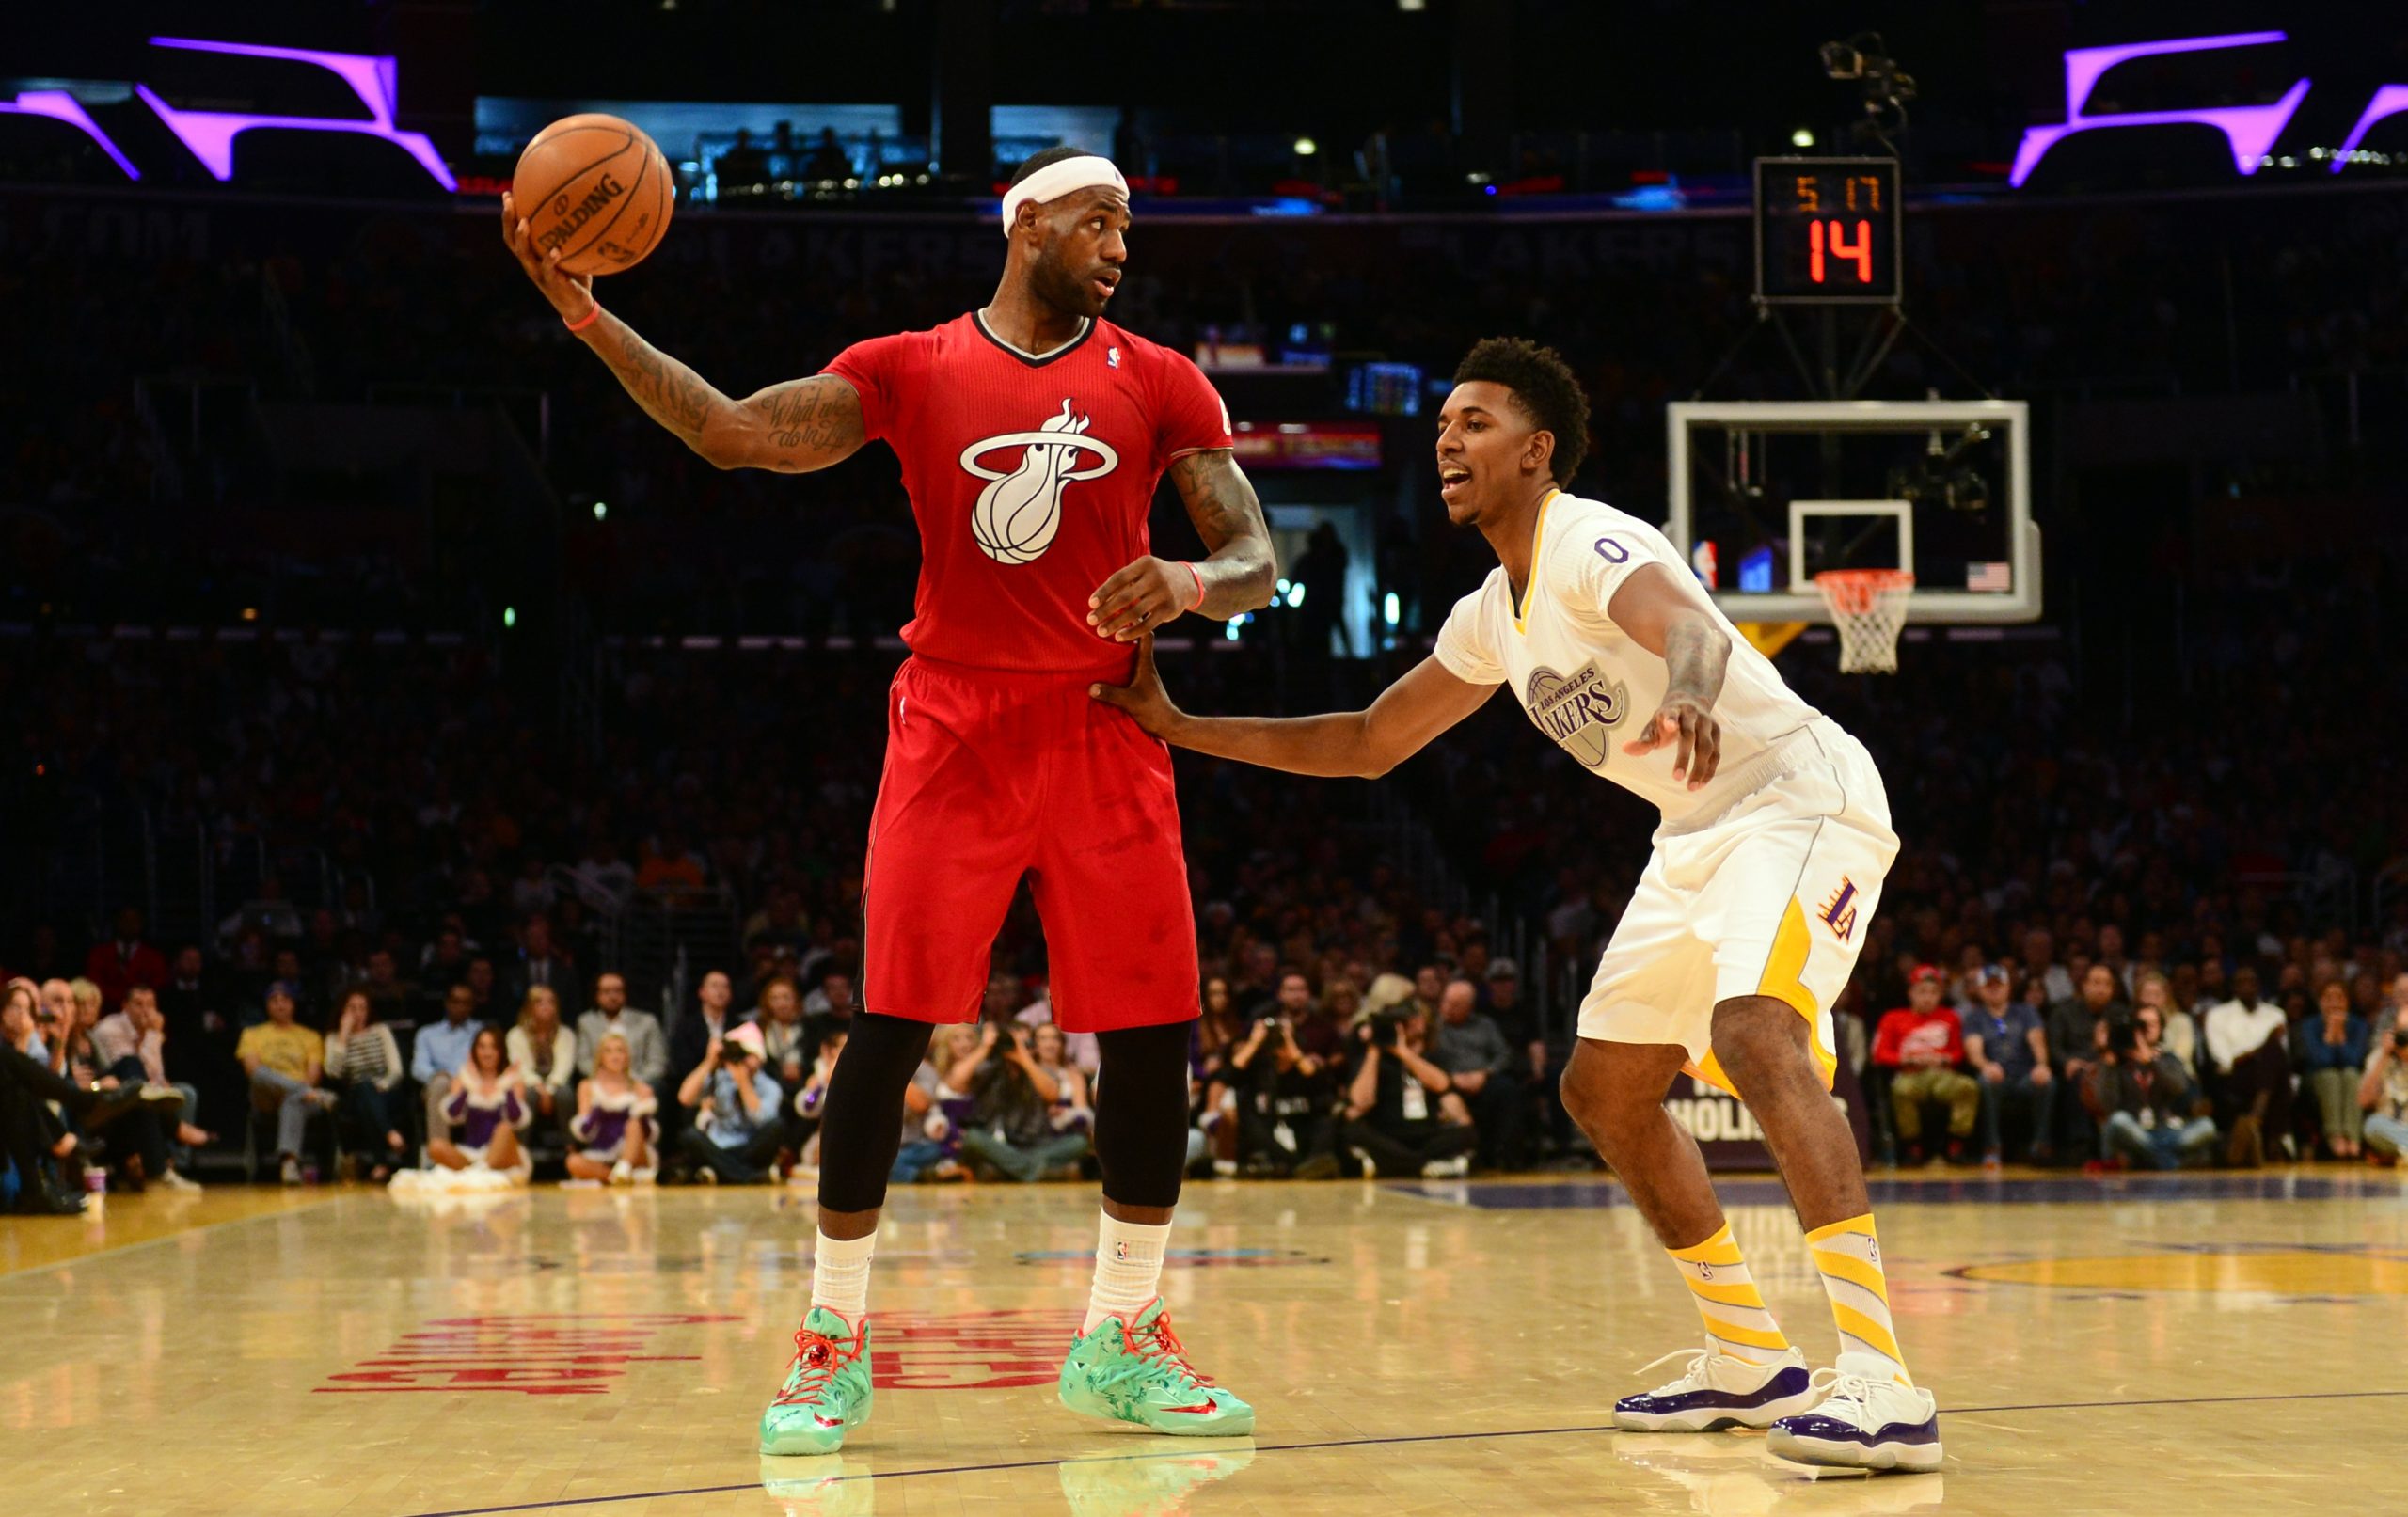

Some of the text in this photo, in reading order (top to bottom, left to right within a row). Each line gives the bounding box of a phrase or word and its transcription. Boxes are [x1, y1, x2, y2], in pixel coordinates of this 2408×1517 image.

[538, 173, 625, 250] SPALDING
[1796, 176, 1881, 212] 5 17
[1809, 219, 1873, 283] 14
[1593, 537, 1630, 564] 0
[1529, 679, 1624, 741] LAKERS
[1540, 667, 1595, 711] LOS ANGELES
